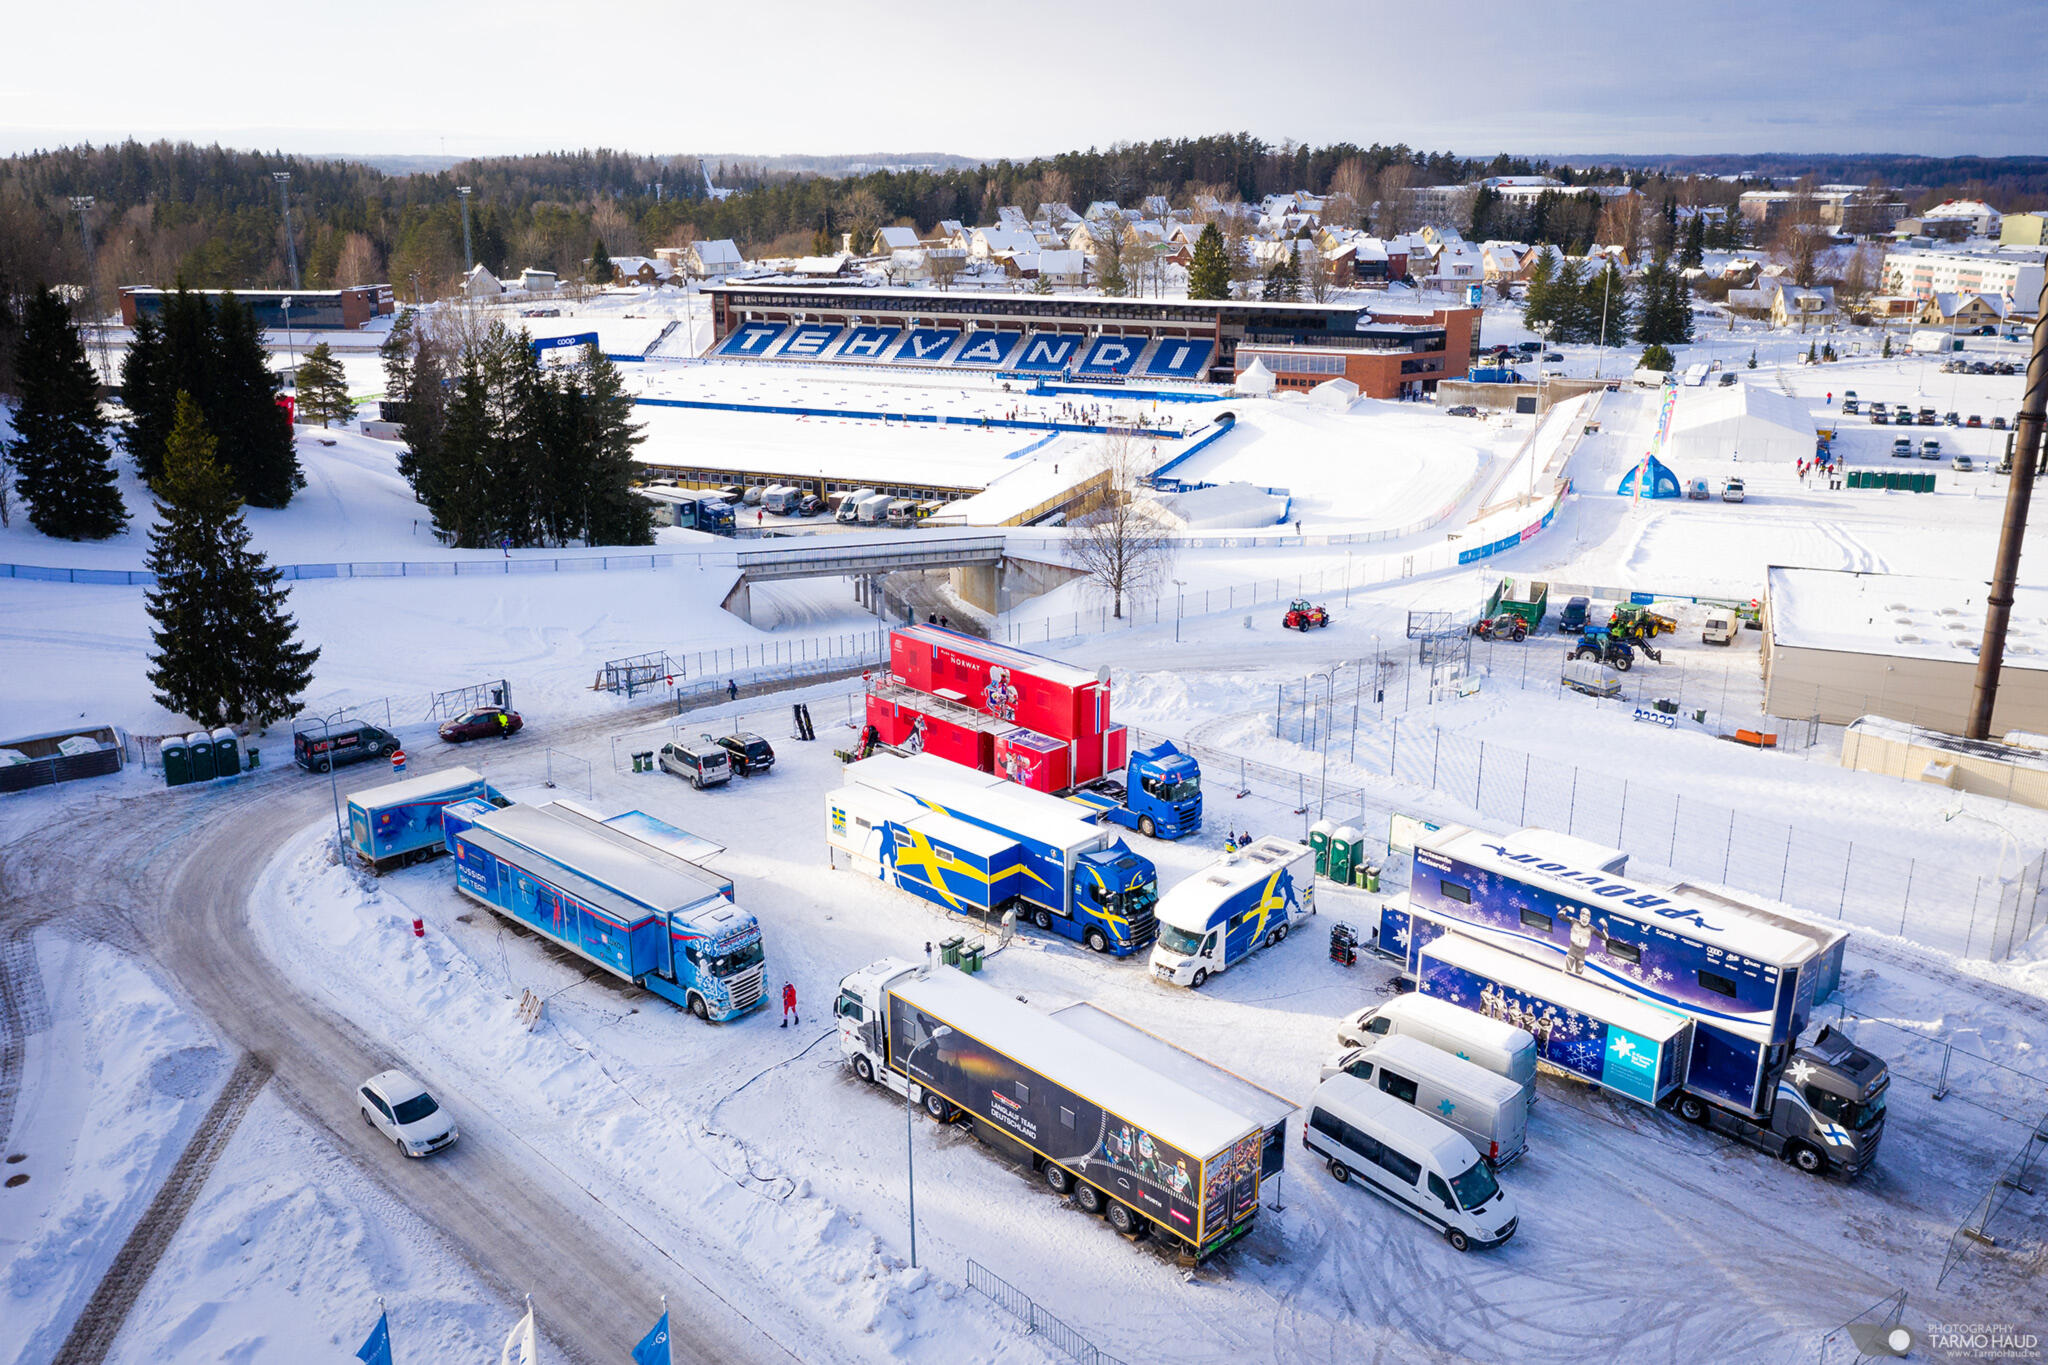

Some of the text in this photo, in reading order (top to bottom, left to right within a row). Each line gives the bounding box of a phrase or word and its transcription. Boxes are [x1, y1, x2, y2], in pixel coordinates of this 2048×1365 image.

[741, 328, 1189, 370] TEHVANDI
[950, 656, 980, 671] NORWAY
[991, 1100, 1020, 1122] LANGLAUF
[1020, 1117, 1037, 1131] TEAM
[991, 1108, 1037, 1140] DEUTSCHLAND
